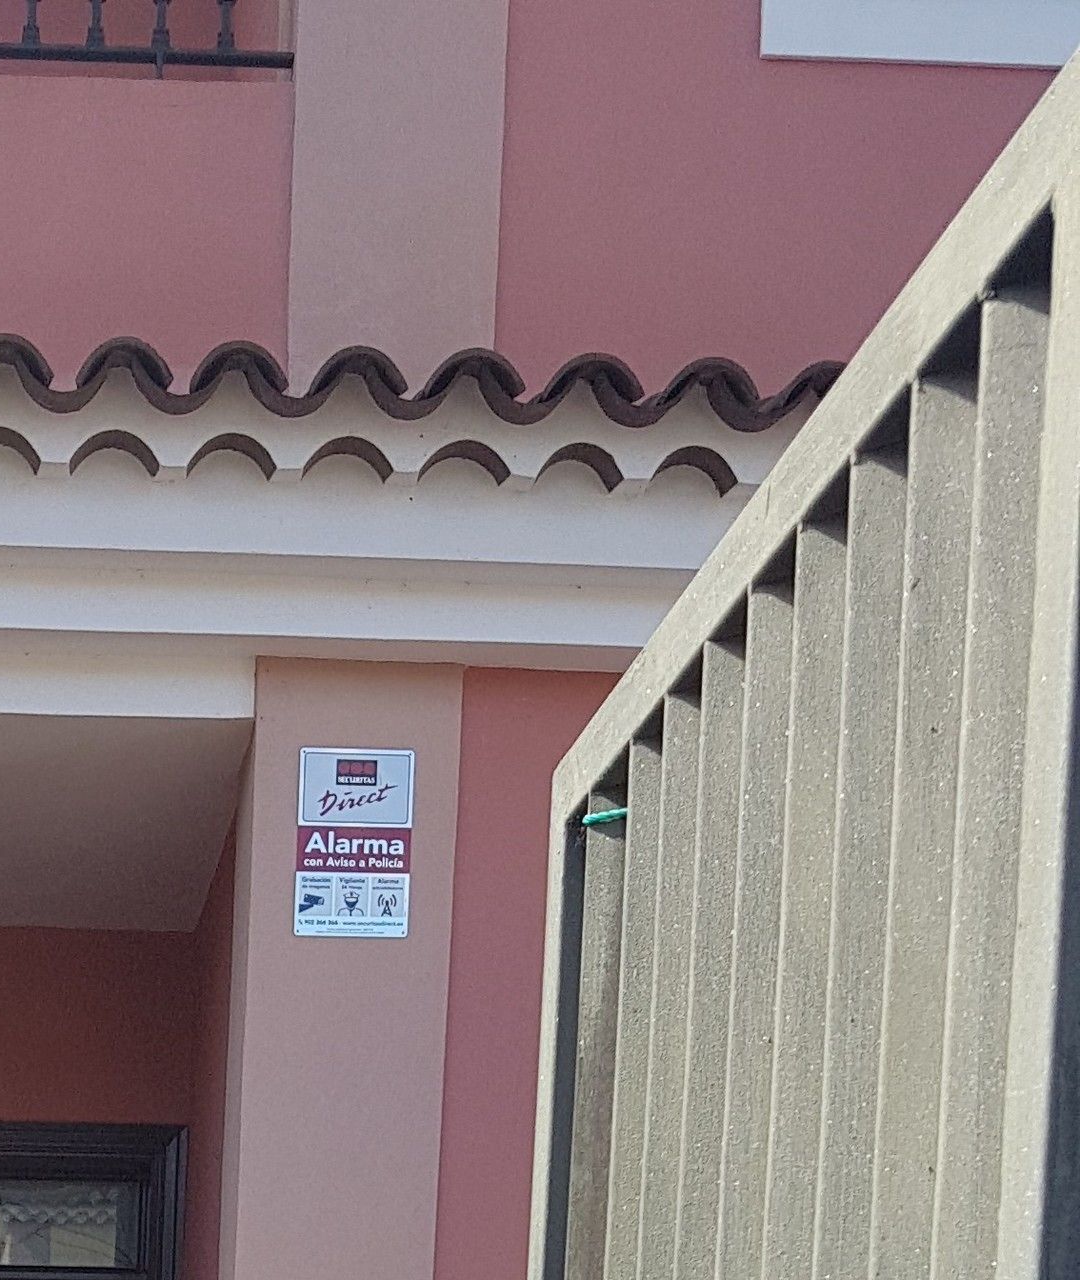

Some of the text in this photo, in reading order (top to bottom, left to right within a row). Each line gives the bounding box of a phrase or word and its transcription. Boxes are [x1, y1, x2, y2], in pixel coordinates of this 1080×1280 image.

[338, 776, 375, 784] SECURITAS
[317, 783, 398, 816] Direct
[305, 831, 404, 855] Alarma
[303, 857, 404, 869] con Aviso a Policía
